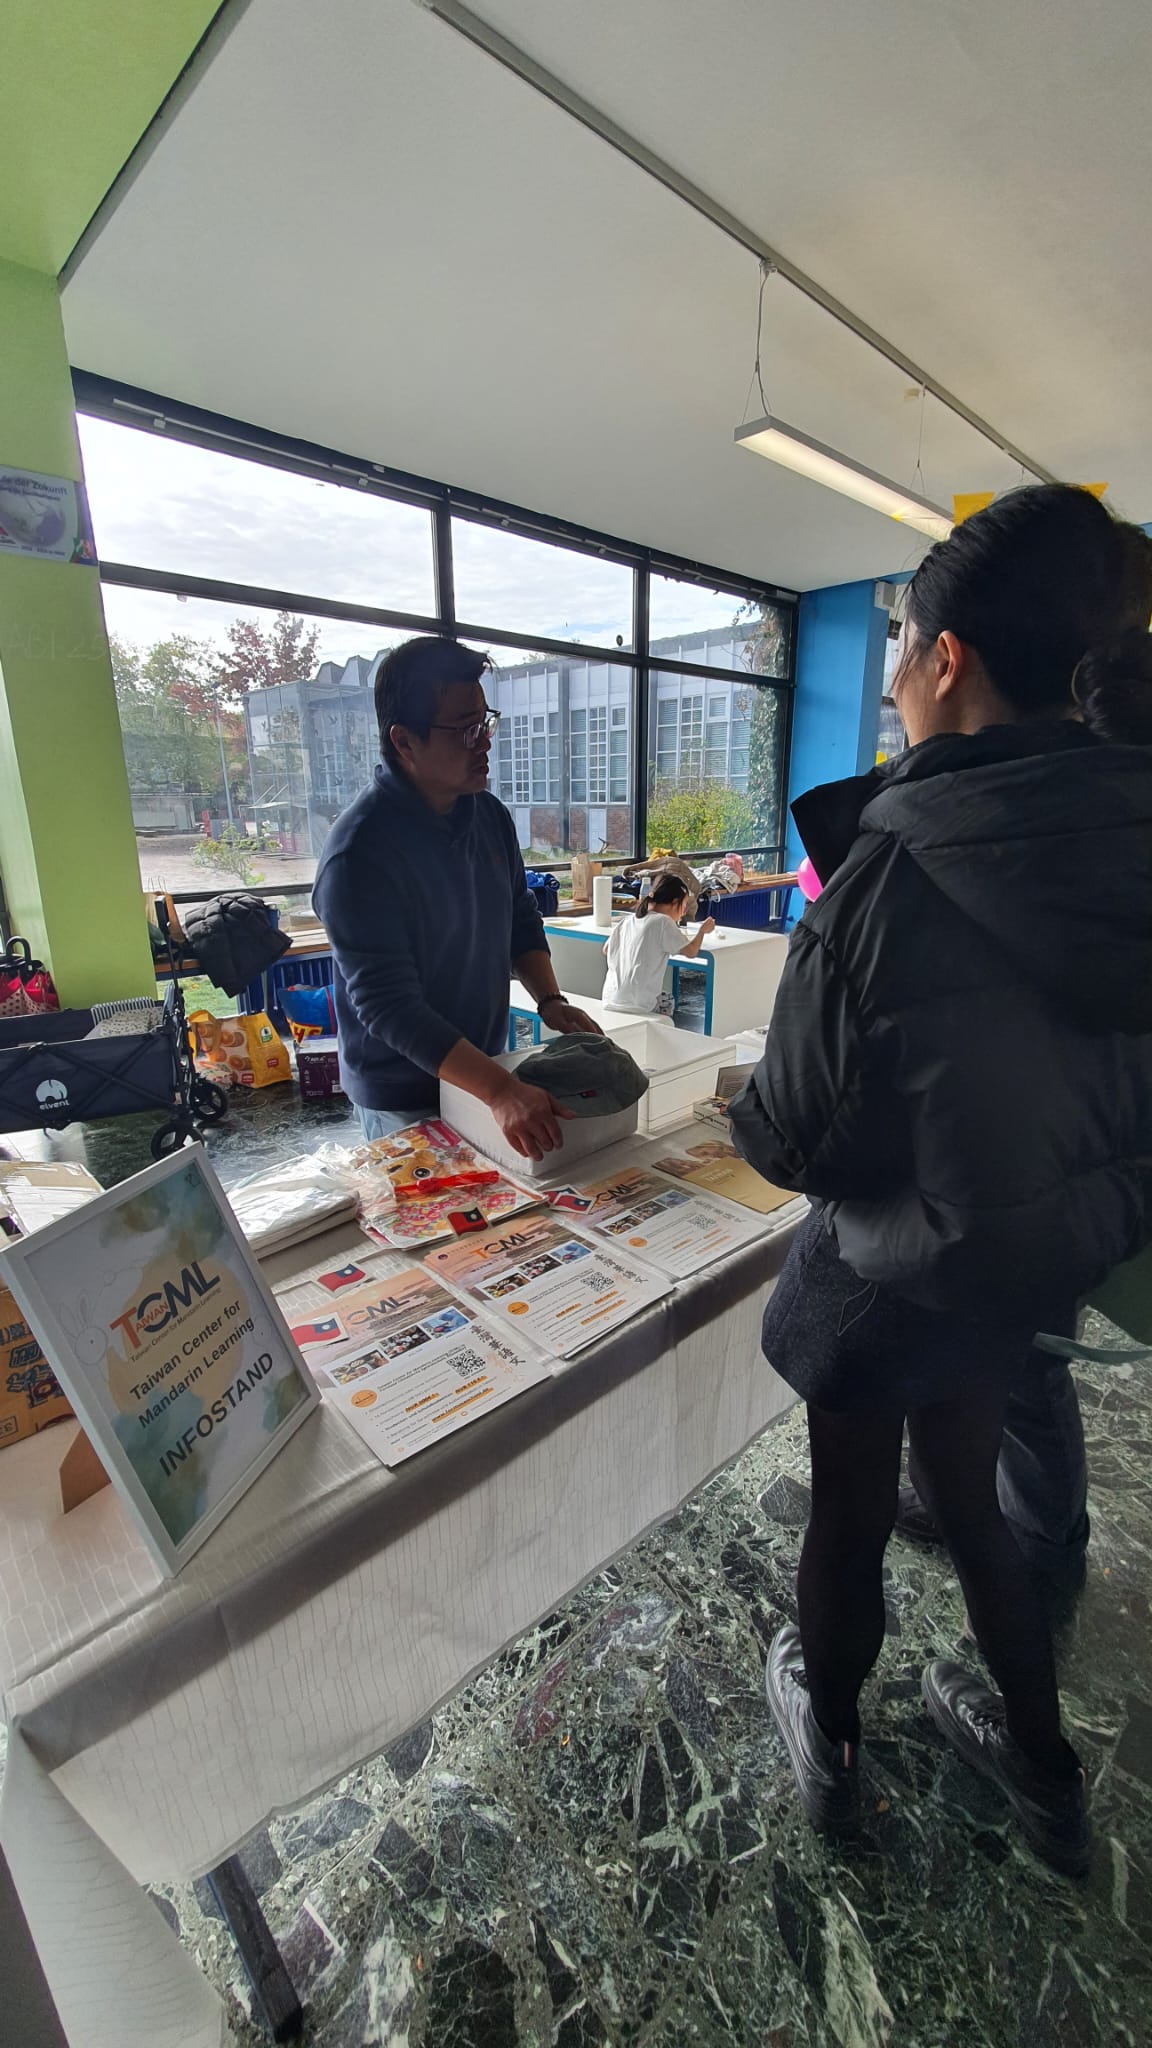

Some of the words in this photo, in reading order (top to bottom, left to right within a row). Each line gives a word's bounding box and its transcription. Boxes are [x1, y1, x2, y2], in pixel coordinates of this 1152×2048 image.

[471, 1232, 535, 1259] TCML
[129, 1354, 182, 1401] Taiwan
[182, 1315, 223, 1356] Center
[223, 1300, 241, 1320] for
[347, 1296, 411, 1326] CML
[138, 1365, 203, 1428] Mandarin
[203, 1318, 256, 1369] Learning
[159, 1352, 274, 1477] INFOSTAND
